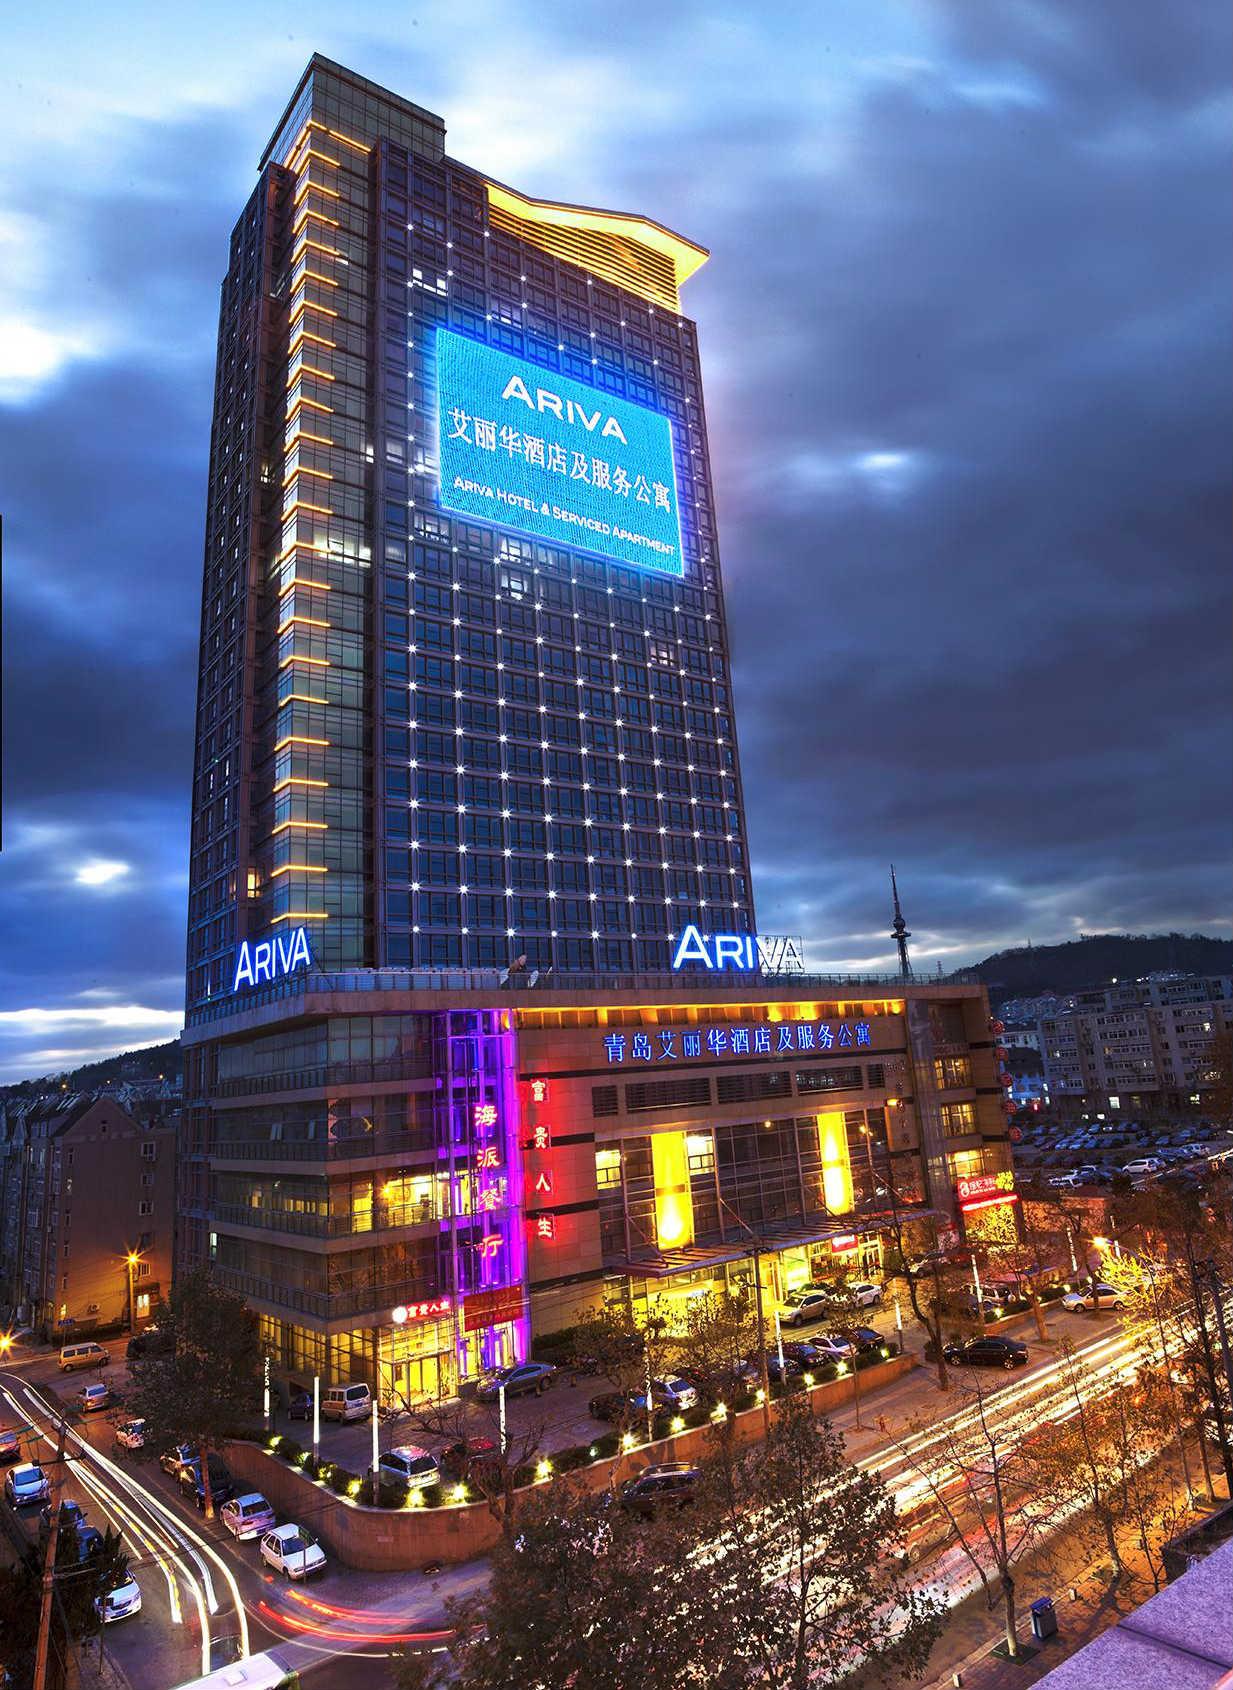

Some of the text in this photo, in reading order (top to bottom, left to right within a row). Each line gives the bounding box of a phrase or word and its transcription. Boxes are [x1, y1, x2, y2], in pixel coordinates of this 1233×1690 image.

[501, 375, 628, 445] ARIVA
[447, 407, 671, 513] 艾丽华酒店及服务公寓
[453, 475, 676, 556] ARIVA HOTEL & SERVICED APARTMENT
[233, 927, 311, 992] ARIVA
[672, 924, 805, 974] ARIVA
[603, 1022, 872, 1064] 青岛艾丽华酒店及服务公寓
[474, 1104, 504, 1258] 海派餐厅
[531, 1079, 553, 1238] 富贵人生
